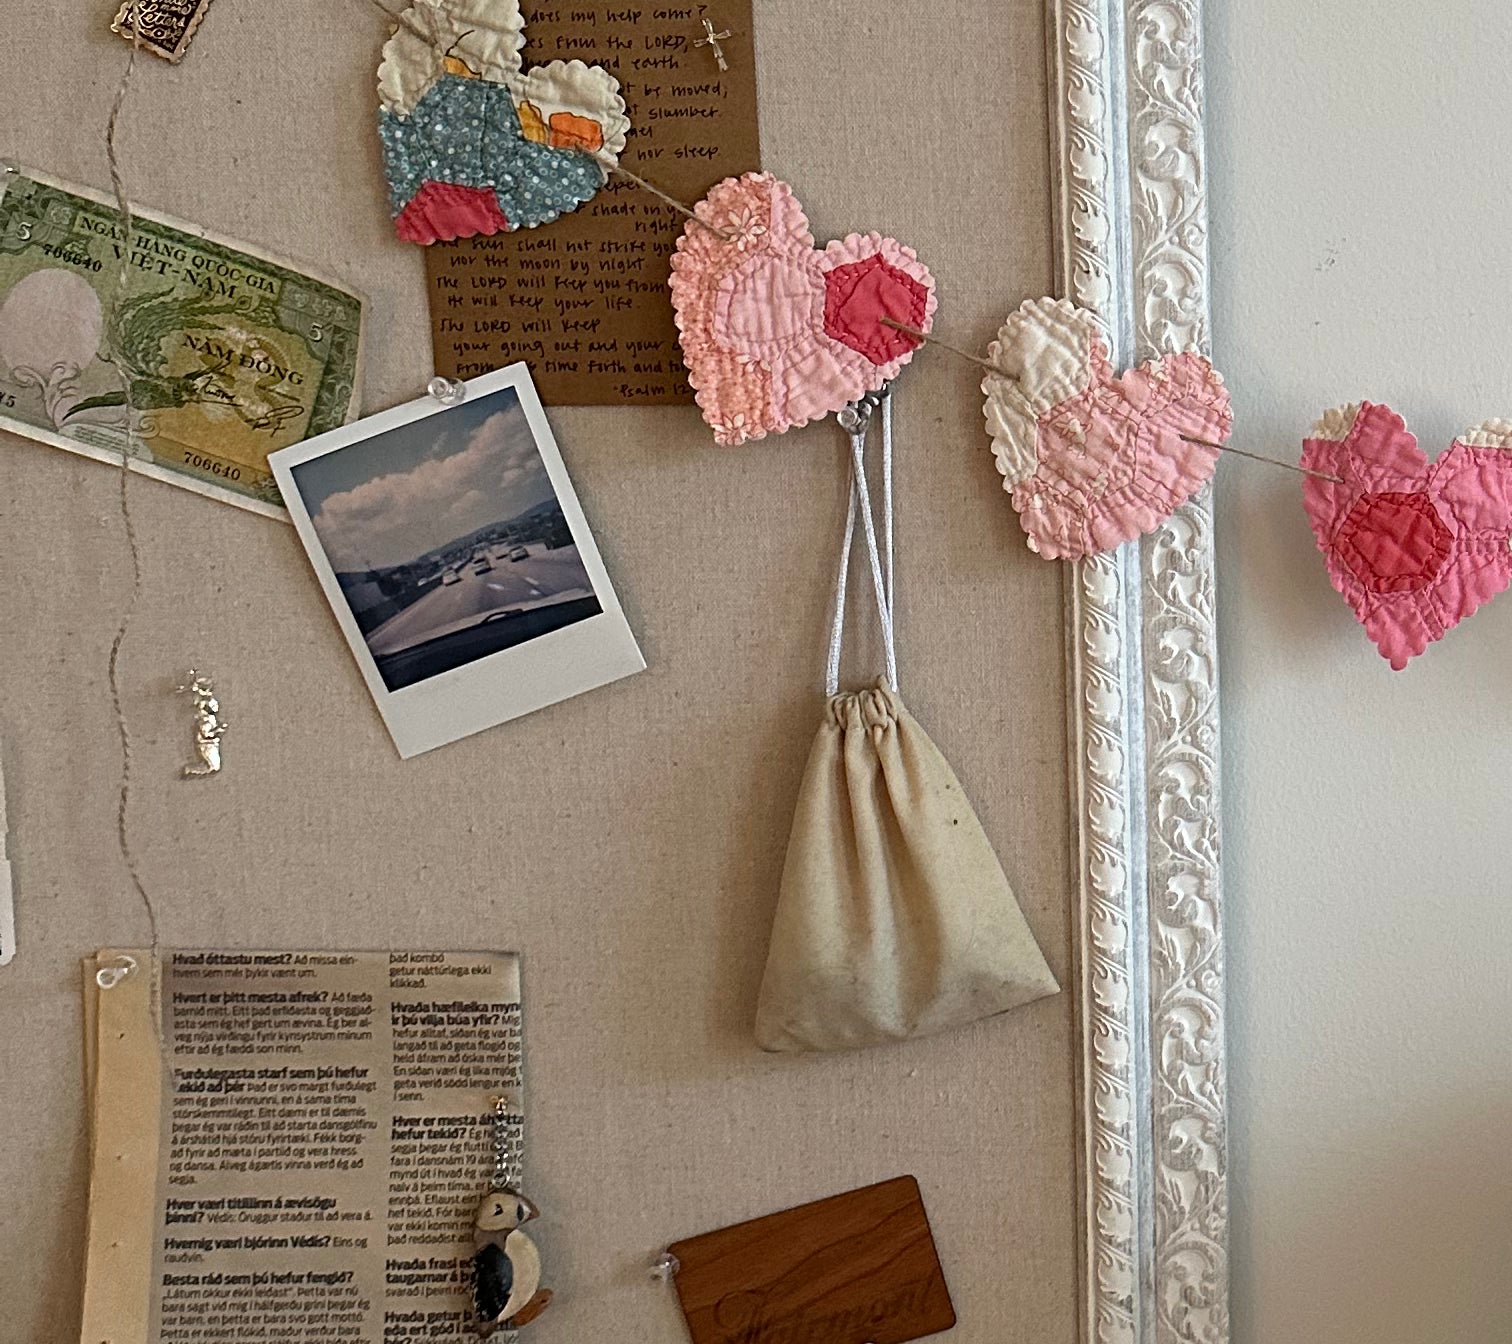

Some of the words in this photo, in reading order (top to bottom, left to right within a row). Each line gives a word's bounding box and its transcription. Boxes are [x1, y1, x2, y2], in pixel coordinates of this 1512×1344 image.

[139, 1, 185, 28] Letters
[530, 9, 560, 22] does
[571, 13, 596, 26] my
[607, 9, 641, 25] help
[607, 35, 632, 48] the
[645, 35, 688, 52] LORD,
[590, 56, 619, 69] and
[645, 84, 660, 98] be
[637, 148, 664, 160] nor
[592, 204, 635, 216] shade
[644, 204, 660, 215] on
[15, 222, 33, 241] 5
[635, 216, 678, 234] right
[472, 237, 504, 250] sun
[517, 237, 557, 252] shall
[566, 239, 592, 252] not
[41, 243, 103, 273] 706640
[450, 255, 476, 267] nor
[484, 255, 509, 268] the
[520, 259, 560, 270] moon
[571, 257, 590, 275] by
[599, 255, 645, 274] night
[437, 276, 458, 288] The
[471, 278, 508, 289] LORD
[517, 276, 545, 289] will
[593, 277, 620, 294] you
[626, 275, 665, 293] from
[448, 294, 464, 307] He
[472, 295, 498, 307] will
[554, 297, 594, 316] your
[308, 321, 324, 343] 5
[440, 319, 464, 332] The
[474, 320, 511, 333] LORD
[522, 319, 551, 332] will
[182, 332, 234, 361] NĂM
[453, 342, 490, 357] your
[501, 340, 545, 358] going
[554, 339, 581, 352] out
[588, 339, 618, 352] and
[626, 340, 664, 357] your
[545, 362, 578, 373] time
[634, 363, 663, 373] and
[184, 451, 241, 481] 706640
[172, 954, 204, 965] Hvað
[206, 952, 252, 965] óttastu
[254, 954, 292, 965] mest?
[173, 992, 207, 1003] Hvert
[210, 995, 222, 1003] er
[223, 992, 248, 1005] þitt
[250, 993, 288, 1003] mesta
[289, 991, 328, 1002] afrek?
[391, 1002, 430, 1012] Hvaða
[432, 1001, 489, 1012] hæfileika
[391, 1015, 400, 1025] ir
[402, 1014, 418, 1026] þú
[420, 1014, 444, 1026] vilja
[447, 1014, 470, 1025] búa
[472, 1014, 500, 1027] yfir?
[257, 1067, 288, 1079] starf
[289, 1069, 316, 1079] sem
[317, 1066, 333, 1080] þú
[335, 1066, 368, 1078] hefur
[178, 1082, 205, 1092] ekið
[207, 1082, 223, 1092] að
[224, 1080, 245, 1094] þér
[392, 1116, 422, 1127] Hver
[423, 1117, 436, 1126] er
[438, 1116, 477, 1126] mesta
[392, 1128, 425, 1140] hefur
[428, 1127, 466, 1139] tekið?
[166, 1198, 196, 1210] Hver
[198, 1199, 224, 1209] væri
[274, 1197, 283, 1208] á
[284, 1196, 336, 1210] ævisögu
[165, 1211, 204, 1225] þinni?
[164, 1238, 213, 1251] Hvernig
[214, 1237, 242, 1249] væri
[244, 1236, 288, 1251] bjórinn
[385, 1258, 426, 1271] Hvaða
[428, 1257, 456, 1269] frasi
[163, 1274, 199, 1286] Besta
[201, 1272, 223, 1285] ráð
[224, 1274, 250, 1285] sem
[252, 1272, 270, 1286] þú
[270, 1272, 305, 1284] hefur
[306, 1271, 354, 1285] fengið?
[450, 1272, 458, 1282] á
[384, 1311, 425, 1323] Hvaða
[427, 1311, 462, 1324] getur
[384, 1326, 407, 1336] eða
[409, 1326, 427, 1334] ert
[430, 1322, 454, 1336] góð
